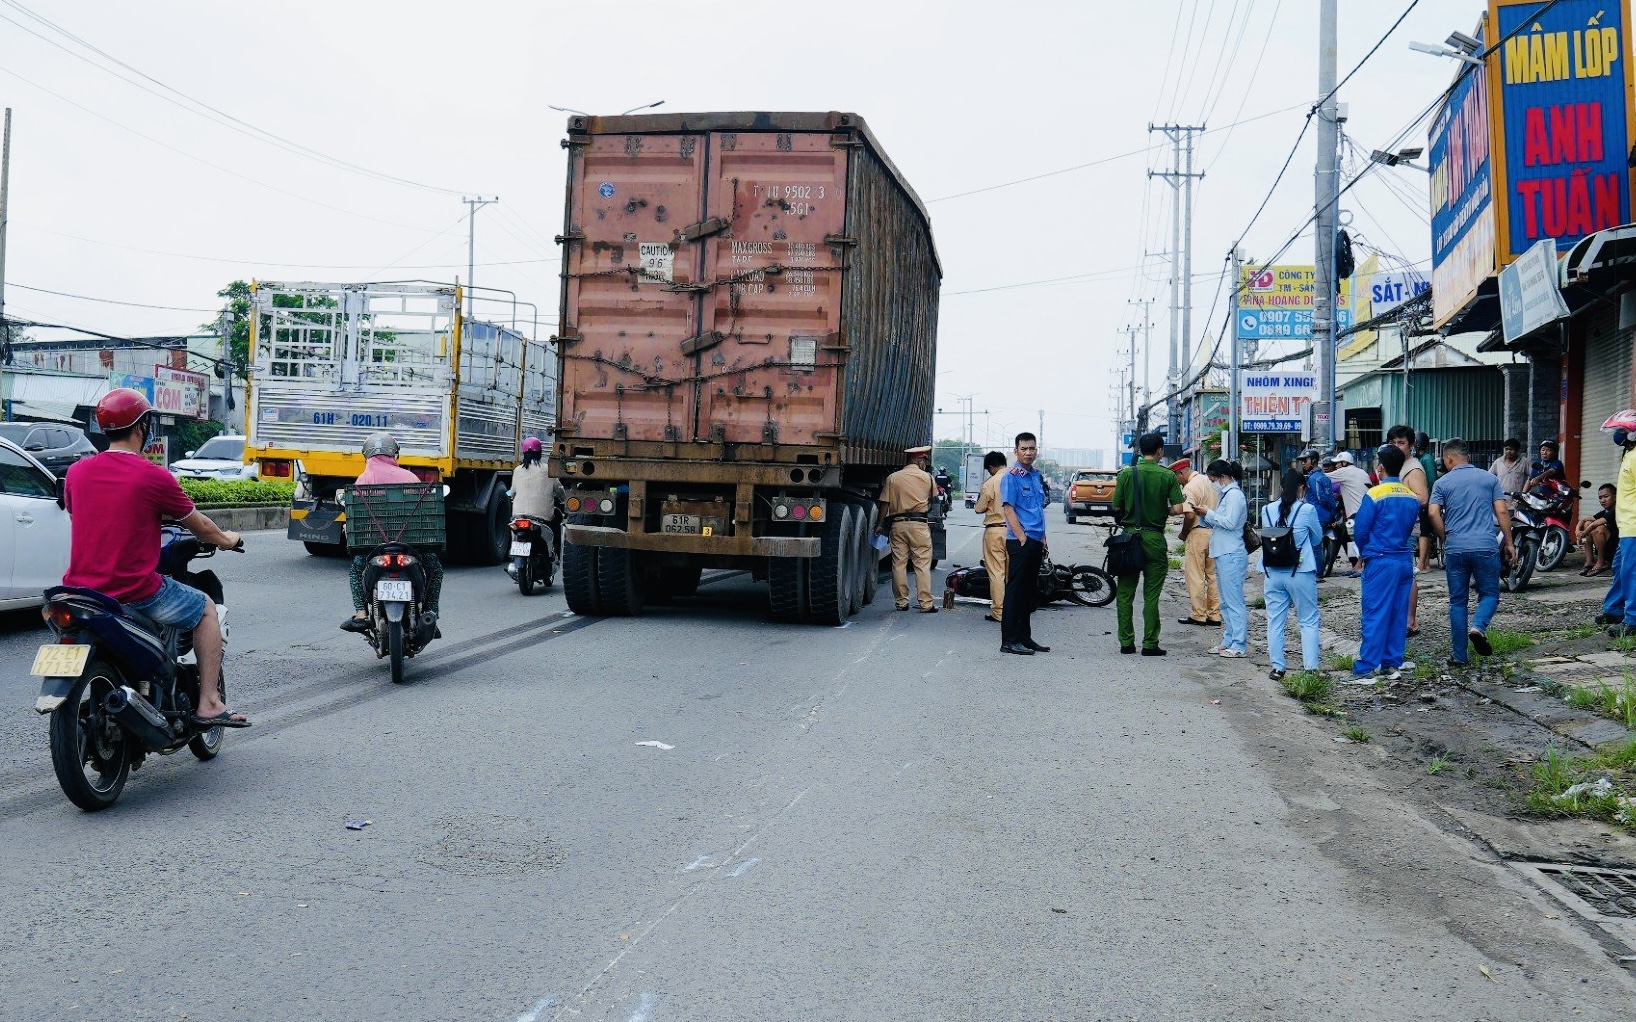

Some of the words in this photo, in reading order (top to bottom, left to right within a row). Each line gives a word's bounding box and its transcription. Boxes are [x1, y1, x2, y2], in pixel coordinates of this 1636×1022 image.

[1505, 22, 1569, 85] MÂM
[1573, 11, 1619, 79] LỐP
[1525, 101, 1604, 167] ANH
[785, 185, 825, 199] 95023
[1517, 167, 1620, 239] TUẤN
[1279, 270, 1301, 280] CÔNG
[1372, 277, 1403, 303] SẮT
[1259, 311, 1291, 323] 0907
[1295, 311, 1314, 322] 55
[1258, 324, 1291, 335] 0889
[1247, 375, 1280, 387] NHÔM
[314, 411, 335, 425] 61H
[672, 515, 690, 525] 61R
[704, 527, 710, 535] 3
[380, 590, 409, 600] 734.21
